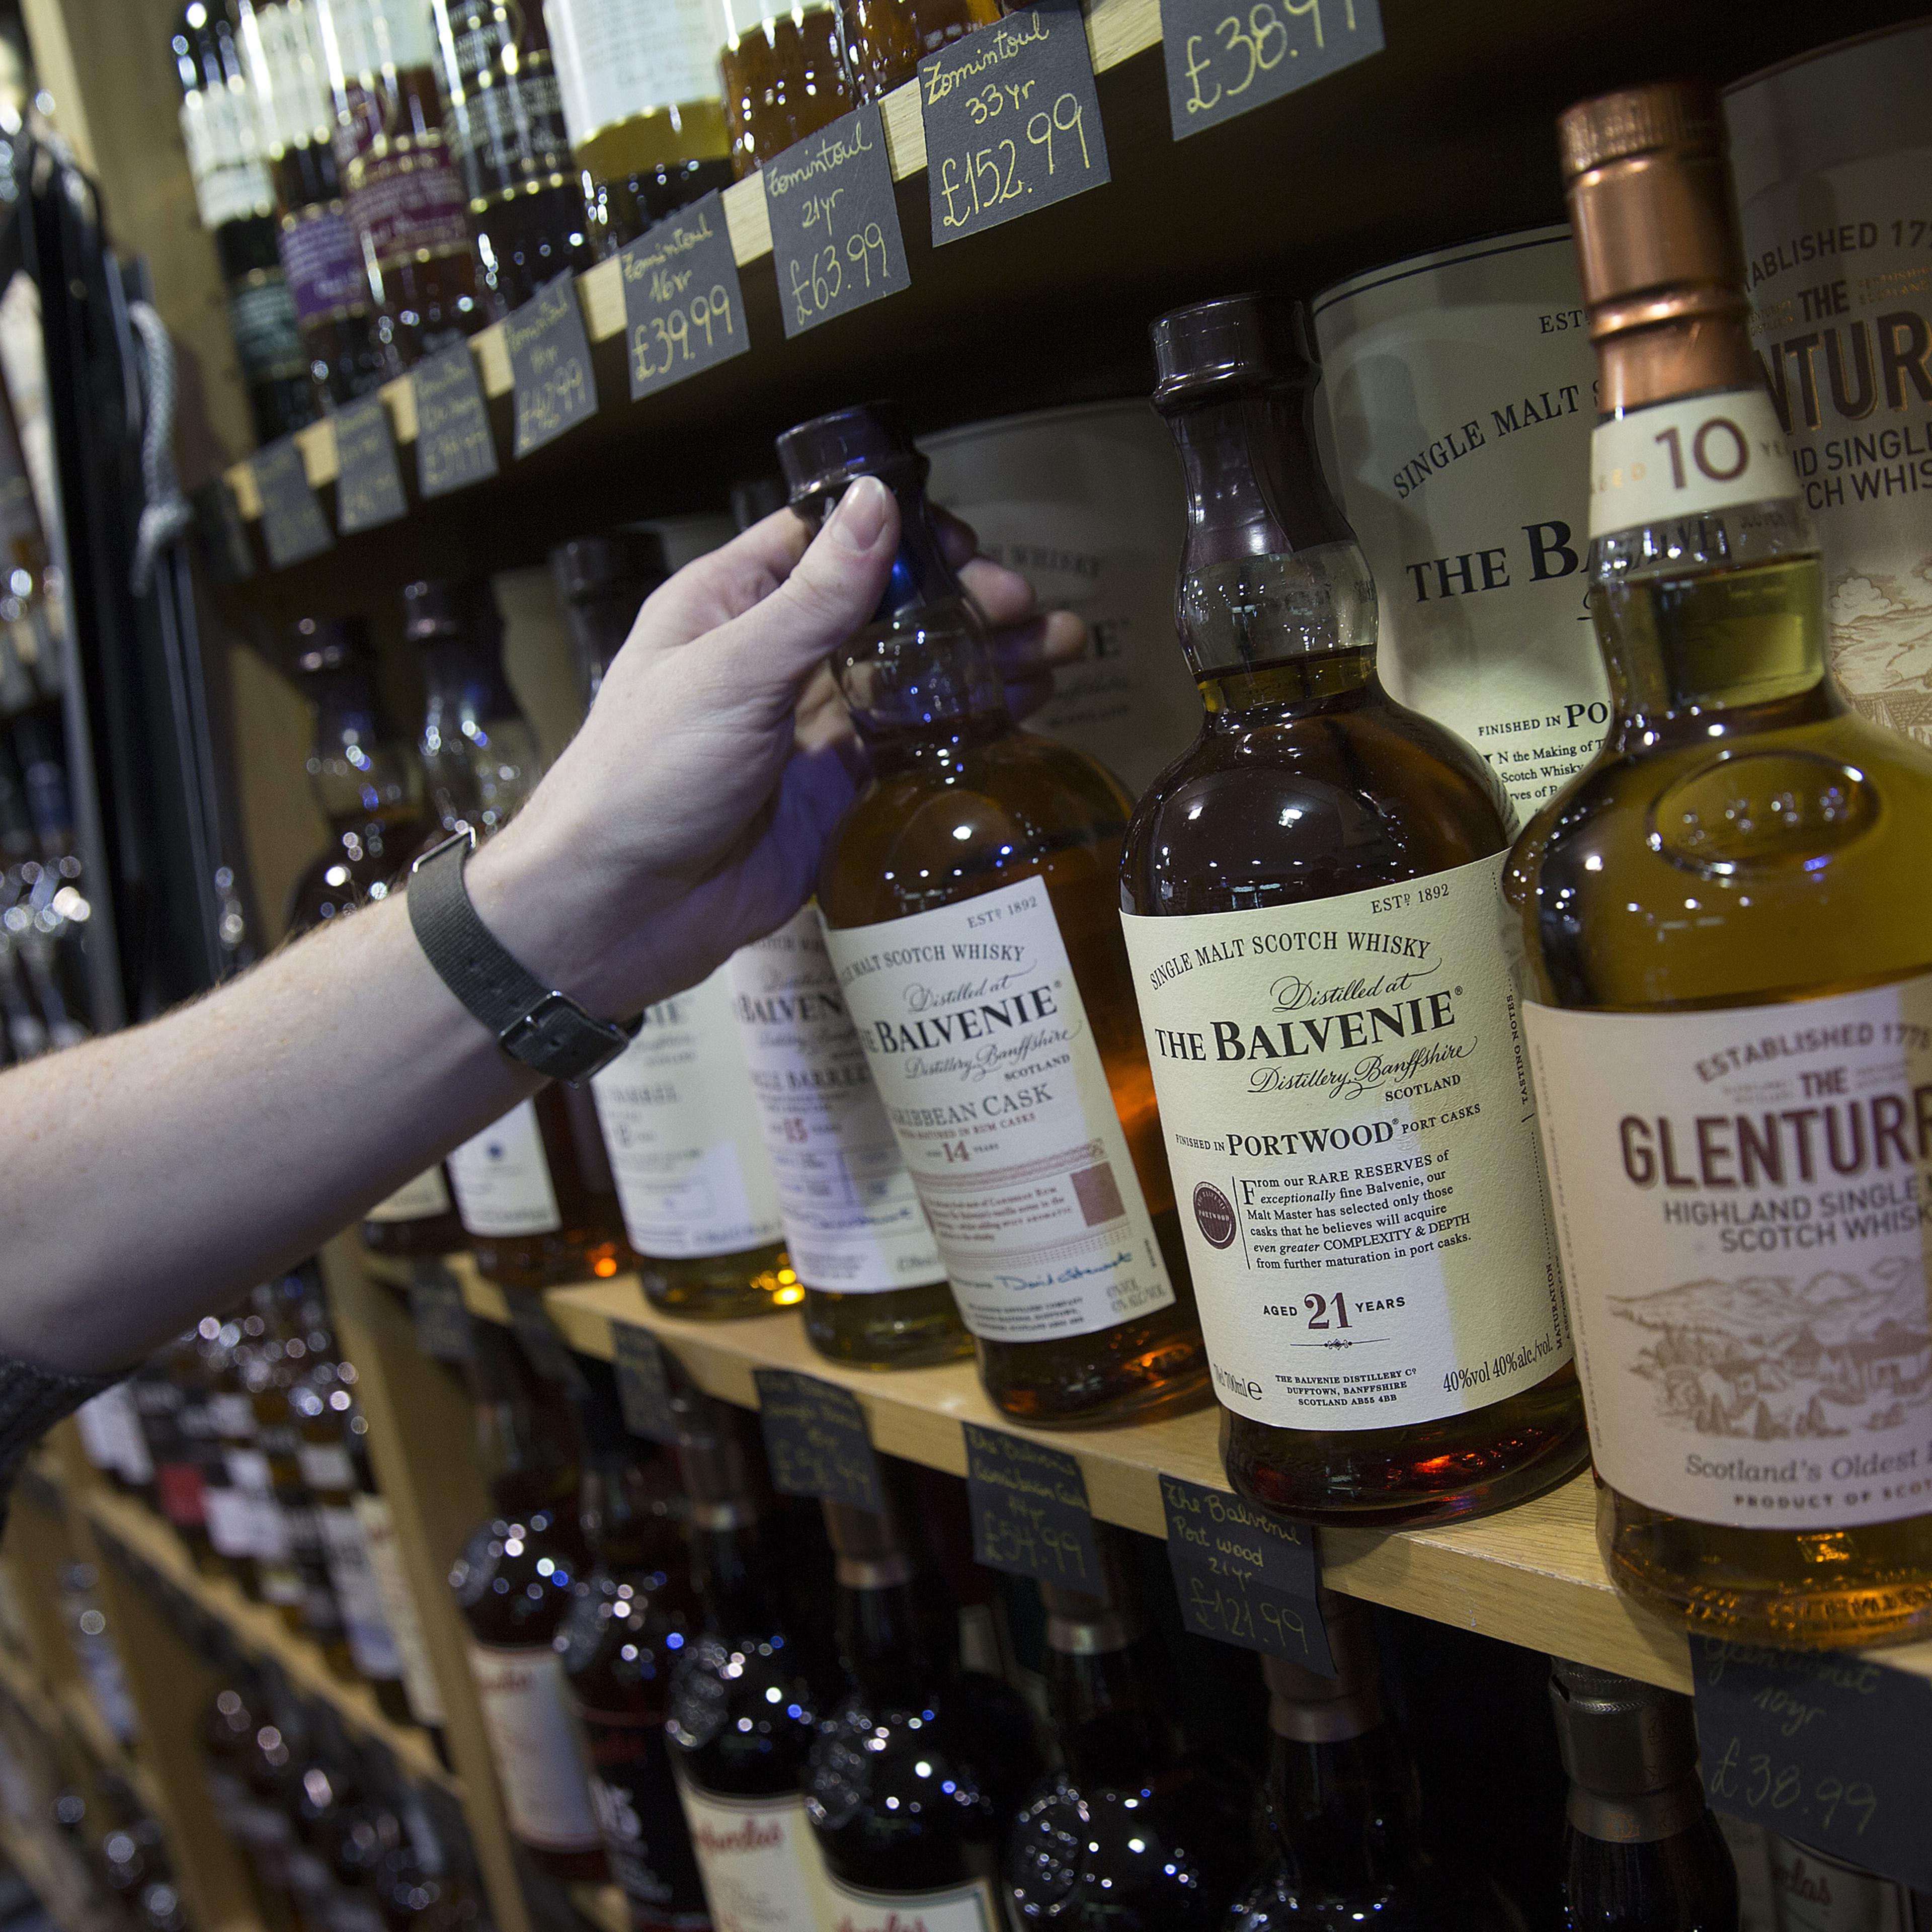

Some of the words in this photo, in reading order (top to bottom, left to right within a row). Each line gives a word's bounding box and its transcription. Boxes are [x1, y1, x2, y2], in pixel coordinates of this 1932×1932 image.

[942, 93, 1090, 227] £152.99
[801, 188, 845, 235] 21yr
[790, 221, 891, 326] £63.99
[1745, 221, 1878, 293] ABLISHED
[1798, 280, 1852, 323] THE
[631, 285, 734, 382] £39.99
[1393, 420, 1486, 500] SINGLE
[1491, 385, 1579, 437] MALT
[1655, 418, 1750, 490] 10
[1406, 547, 1510, 603] THE
[1478, 719, 1540, 737] FINISHED
[1545, 715, 1561, 727] IN
[1513, 751, 1530, 763] the
[1533, 745, 1577, 760] Making
[1580, 740, 1593, 753] of
[1501, 769, 1538, 783] Scotch
[1535, 786, 1547, 798] of
[1007, 896, 1039, 916] 1892
[1418, 883, 1450, 905] 1892
[884, 945, 945, 968] SCOTCH
[952, 943, 1025, 962] WHISKY
[1150, 952, 1193, 990] SINGLE
[1194, 938, 1245, 966] MALT
[1252, 931, 1338, 955] SCOTCH
[1347, 931, 1431, 959] WHISKY
[903, 977, 988, 1012] Distilled
[1269, 975, 1385, 1013] Distilled
[1386, 957, 1442, 993] at
[1506, 994, 1519, 1040] NOTES
[1155, 1028, 1207, 1061] THE
[1694, 1021, 1875, 1082] ESTABLISHED
[1005, 1053, 1071, 1082] SCOTLAND
[1344, 1036, 1478, 1100] Banffshire
[1514, 1045, 1528, 1105] TASTING
[1800, 1066, 1849, 1100] THE
[982, 1082, 1053, 1118] CASK
[1385, 1074, 1462, 1102] SCOTLAND
[999, 1112, 1036, 1129] CASKS
[1175, 1134, 1211, 1150] FINISHED
[1214, 1141, 1226, 1152] IN
[1402, 1117, 1436, 1134] PORT
[1440, 1103, 1481, 1124] CASKS
[942, 1140, 971, 1163] 14
[1240, 1179, 1280, 1205] From
[1284, 1178, 1304, 1187] our
[1308, 1170, 1349, 1184] RARE
[1354, 1154, 1433, 1180] RESERVES
[1437, 1149, 1450, 1162] of
[1260, 1189, 1336, 1206] exceptionally
[1340, 1186, 1363, 1199] fine
[1366, 1175, 1424, 1195] Balvenie,
[1427, 1170, 1446, 1183] our
[1247, 1210, 1270, 1220] Malt
[1274, 1209, 1313, 1221] Master
[1316, 1208, 1337, 1218] has
[1340, 1198, 1390, 1216] selected
[1393, 1193, 1420, 1208] only
[1423, 1186, 1454, 1201] those
[1250, 1227, 1277, 1237] casks
[1280, 1226, 1303, 1236] that
[1306, 1225, 1319, 1236] he
[1323, 1221, 1373, 1235] believes
[1376, 1214, 1400, 1228] will
[1404, 1205, 1447, 1223] acquire
[1663, 1195, 1812, 1227] HIGHLAND
[1254, 1243, 1276, 1253] even
[1280, 1242, 1320, 1255] greater
[1323, 1227, 1412, 1251] COMPLEXITY
[1415, 1226, 1426, 1237] &
[1428, 1213, 1471, 1234] DEPTH
[1257, 1258, 1280, 1269] from
[1284, 1256, 1322, 1269] further
[1325, 1251, 1391, 1267] maturation
[1394, 1247, 1406, 1258] in
[1410, 1241, 1434, 1258] port
[1438, 1234, 1472, 1249] casks.
[1720, 1225, 1838, 1254] SCOTCH
[1263, 1305, 1298, 1316] AGED
[1304, 1292, 1353, 1330] 21
[1355, 1296, 1406, 1313] YEARS
[1546, 1263, 1563, 1351] MATURATION
[1275, 1374, 1293, 1383] THE
[1295, 1376, 1340, 1384] BALVENIE
[1343, 1370, 1402, 1384] DISTILLERY
[1286, 1386, 1340, 1396] DUFFTOWN,
[1343, 1380, 1407, 1395] BANFFSHIRE
[1442, 1361, 1491, 1393] 40%vol
[1299, 1398, 1348, 1406] SCOTLAND
[1378, 1394, 1397, 1403] 4BB
[1684, 1453, 1822, 1484] Scotland's
[1831, 1448, 1918, 1481] Oldest
[1164, 1482, 1201, 1513] The
[1733, 1492, 1834, 1510] PRODUCT
[1845, 1490, 1872, 1506] OF
[1190, 1577, 1308, 1655] £121.99
[1711, 1736, 1878, 1835] £38.99
